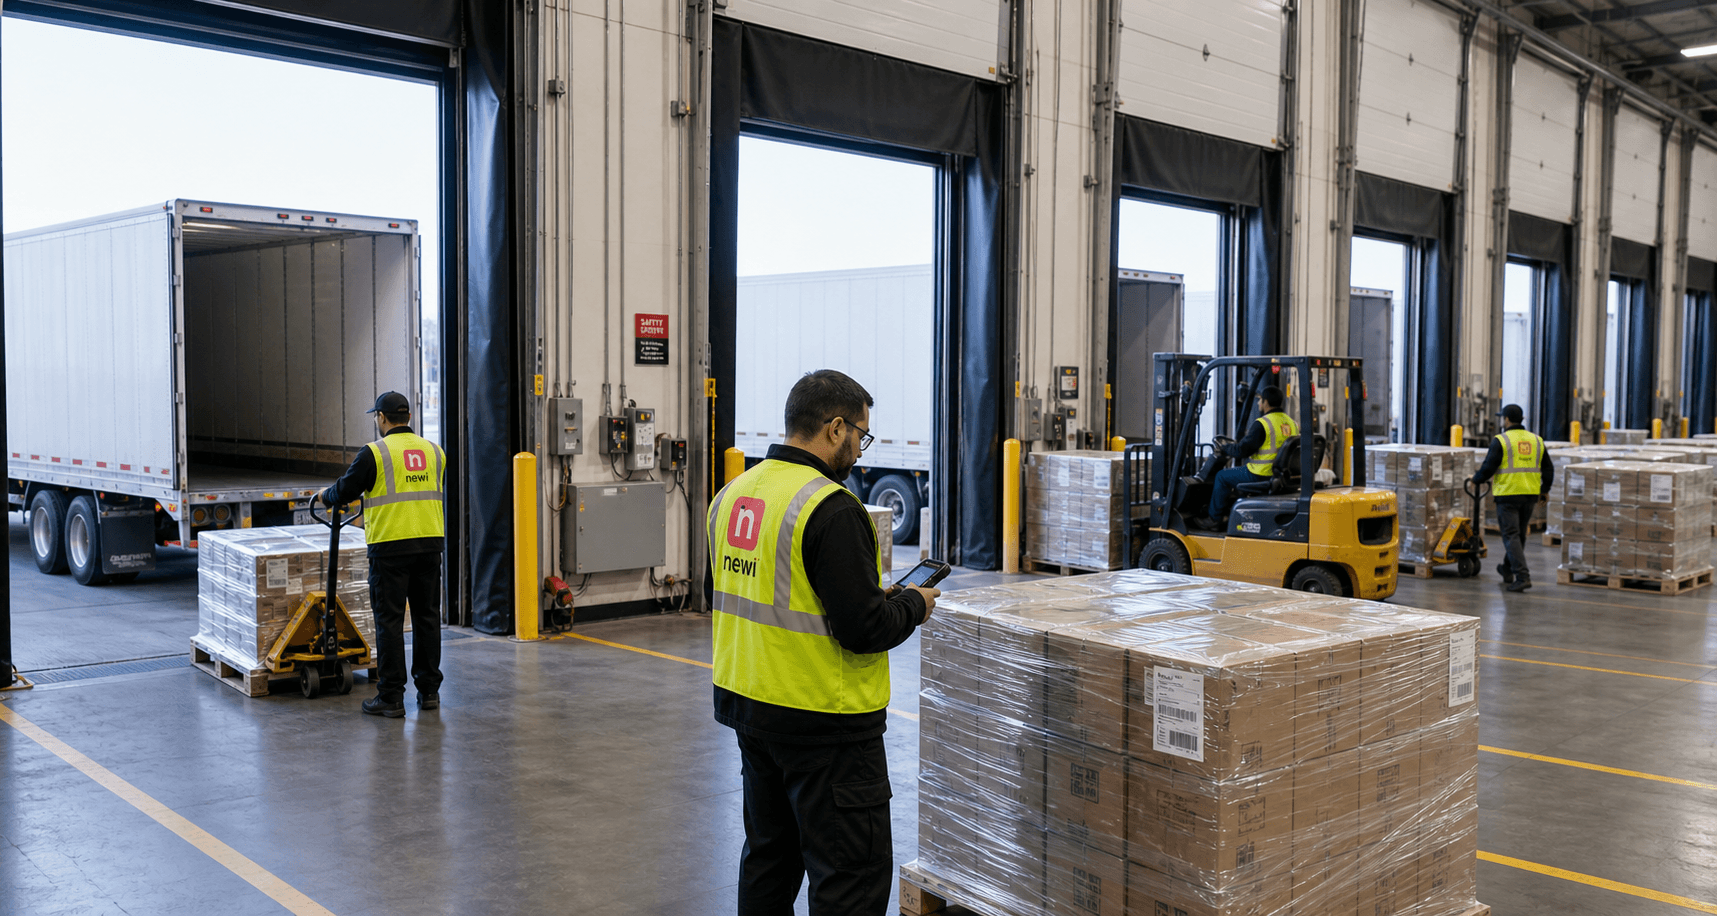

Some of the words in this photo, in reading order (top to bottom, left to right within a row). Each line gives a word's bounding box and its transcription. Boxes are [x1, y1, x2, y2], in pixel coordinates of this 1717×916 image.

[408, 453, 422, 467] n
[406, 472, 429, 482] newi
[723, 555, 757, 577] newi
